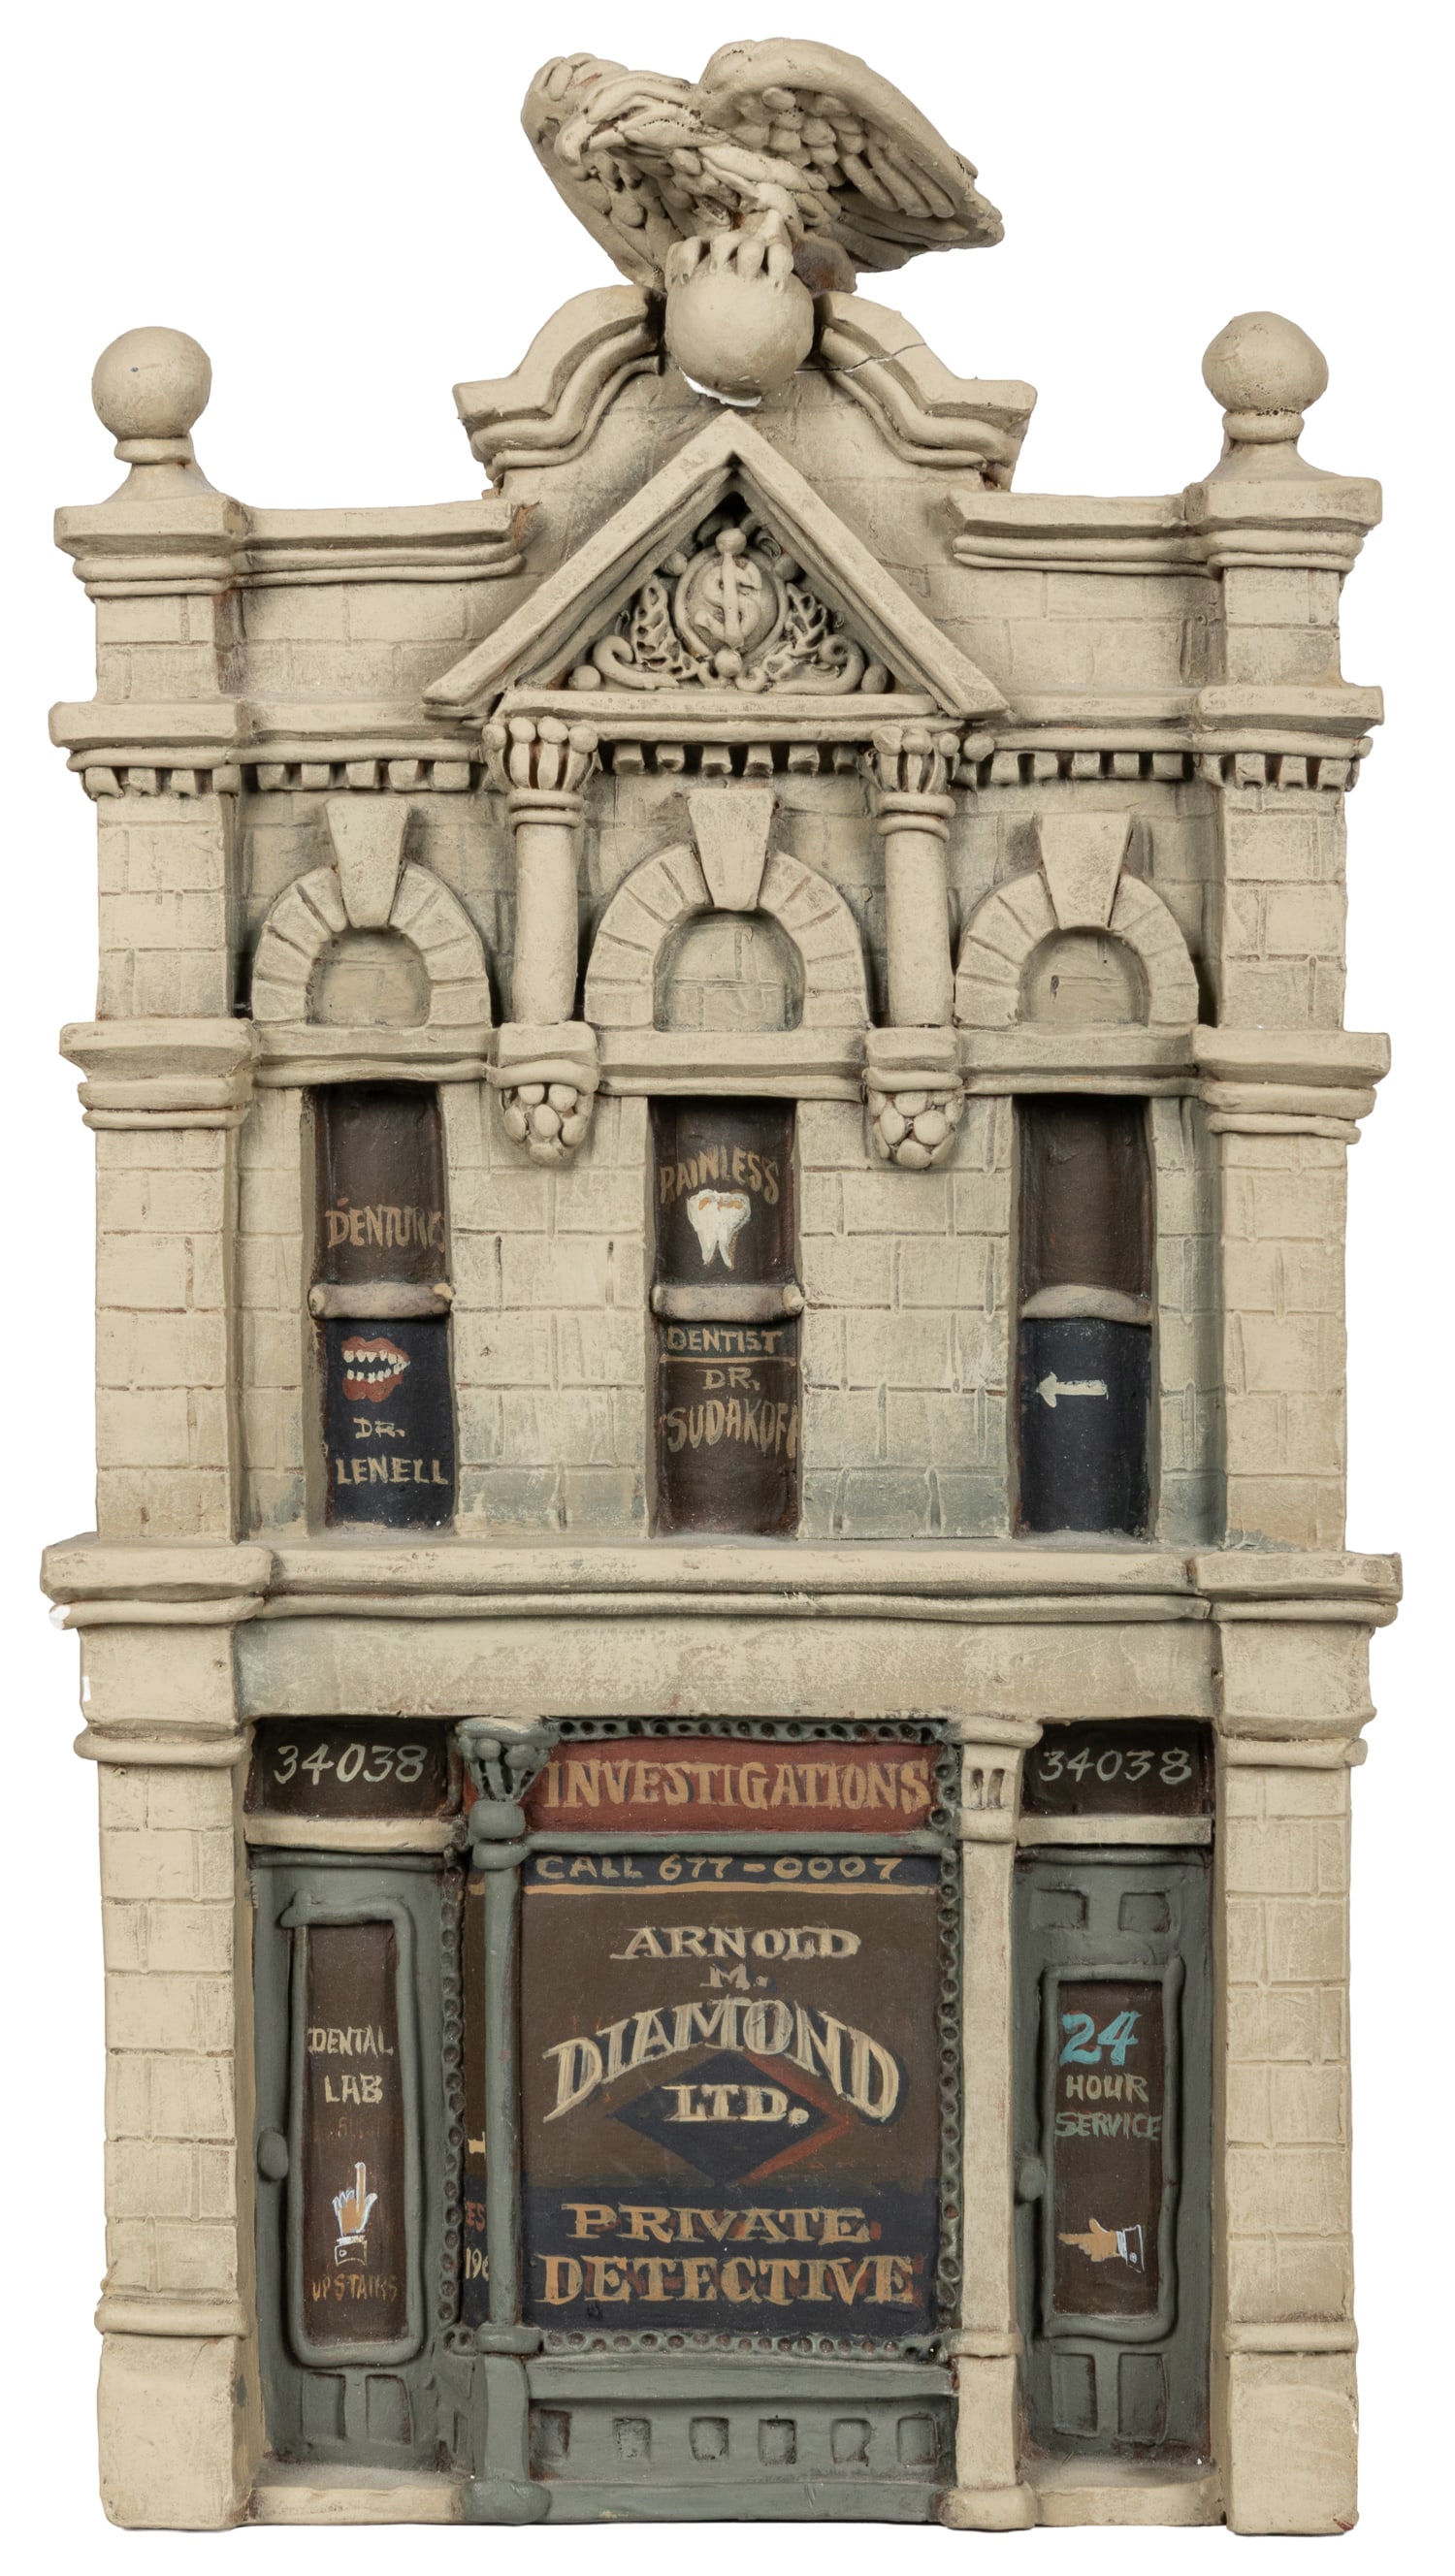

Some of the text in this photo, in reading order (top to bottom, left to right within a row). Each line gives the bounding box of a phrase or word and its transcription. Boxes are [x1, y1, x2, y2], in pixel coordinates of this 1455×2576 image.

[660, 1145, 780, 1206] PAINLESS
[666, 1326, 783, 1354] DENTIST
[353, 1417, 404, 1439] DR.
[336, 1456, 448, 1486] LENELL
[274, 1743, 428, 1786] 34038
[1039, 1747, 1192, 1785] 34038
[542, 1758, 932, 1814] INVESTIGATIONS
[535, 1854, 902, 1882] CALL 677-0007
[610, 1926, 862, 1961] ARNOLD
[699, 1963, 769, 1989] M.
[307, 2025, 394, 2058] DENTAL
[1058, 2010, 1142, 2066] 24
[542, 1995, 900, 2123] DIAMOND
[324, 2074, 383, 2105] LAB
[661, 2084, 810, 2126] LTD.
[1066, 2073, 1148, 2103] HOUR
[1054, 2110, 1162, 2141] SERVICE
[562, 2203, 873, 2245] PRIVATE
[534, 2253, 915, 2305] DETECTIVE
